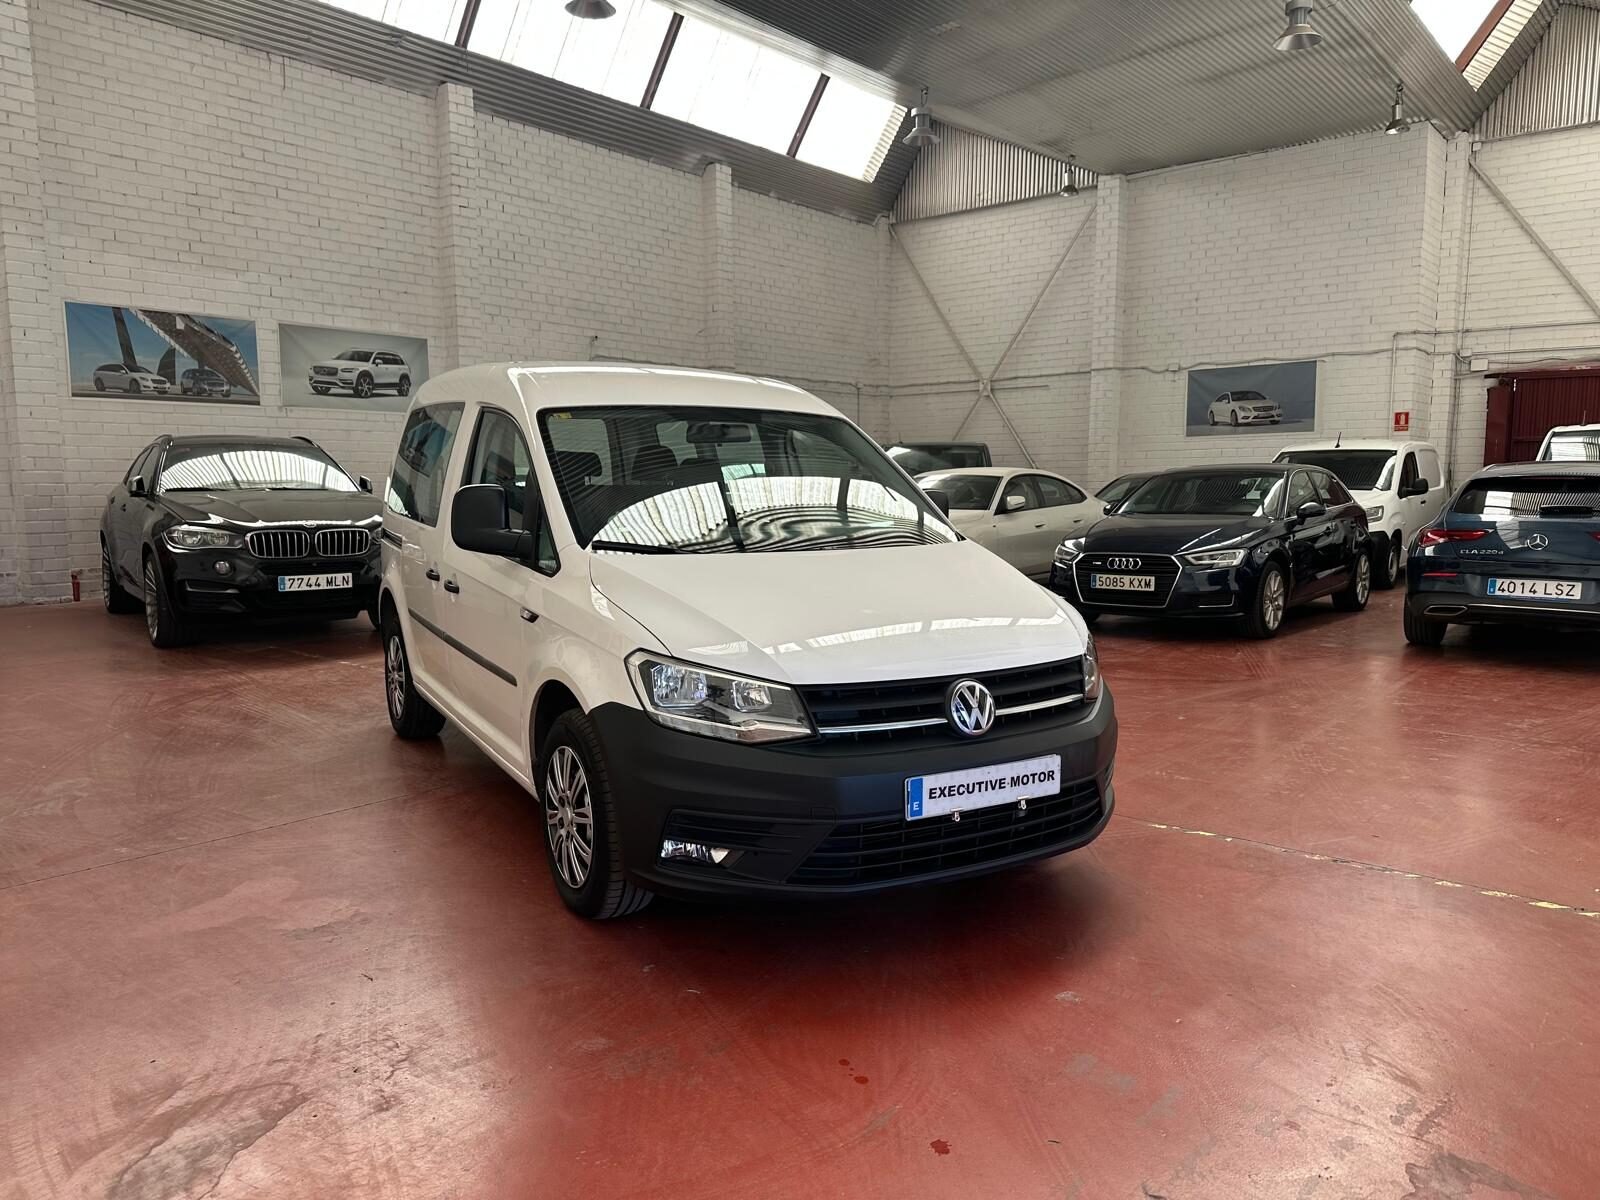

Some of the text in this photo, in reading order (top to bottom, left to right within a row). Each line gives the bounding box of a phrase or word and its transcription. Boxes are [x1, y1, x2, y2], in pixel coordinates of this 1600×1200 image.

[287, 575, 350, 590] 7744 MLN
[1098, 576, 1126, 588] 5085
[1129, 577, 1152, 589] KXM
[1497, 581, 1576, 597] 4014 LSZ
[928, 769, 1055, 800] EXECUTIVE MOTOR
[913, 801, 920, 811] E
